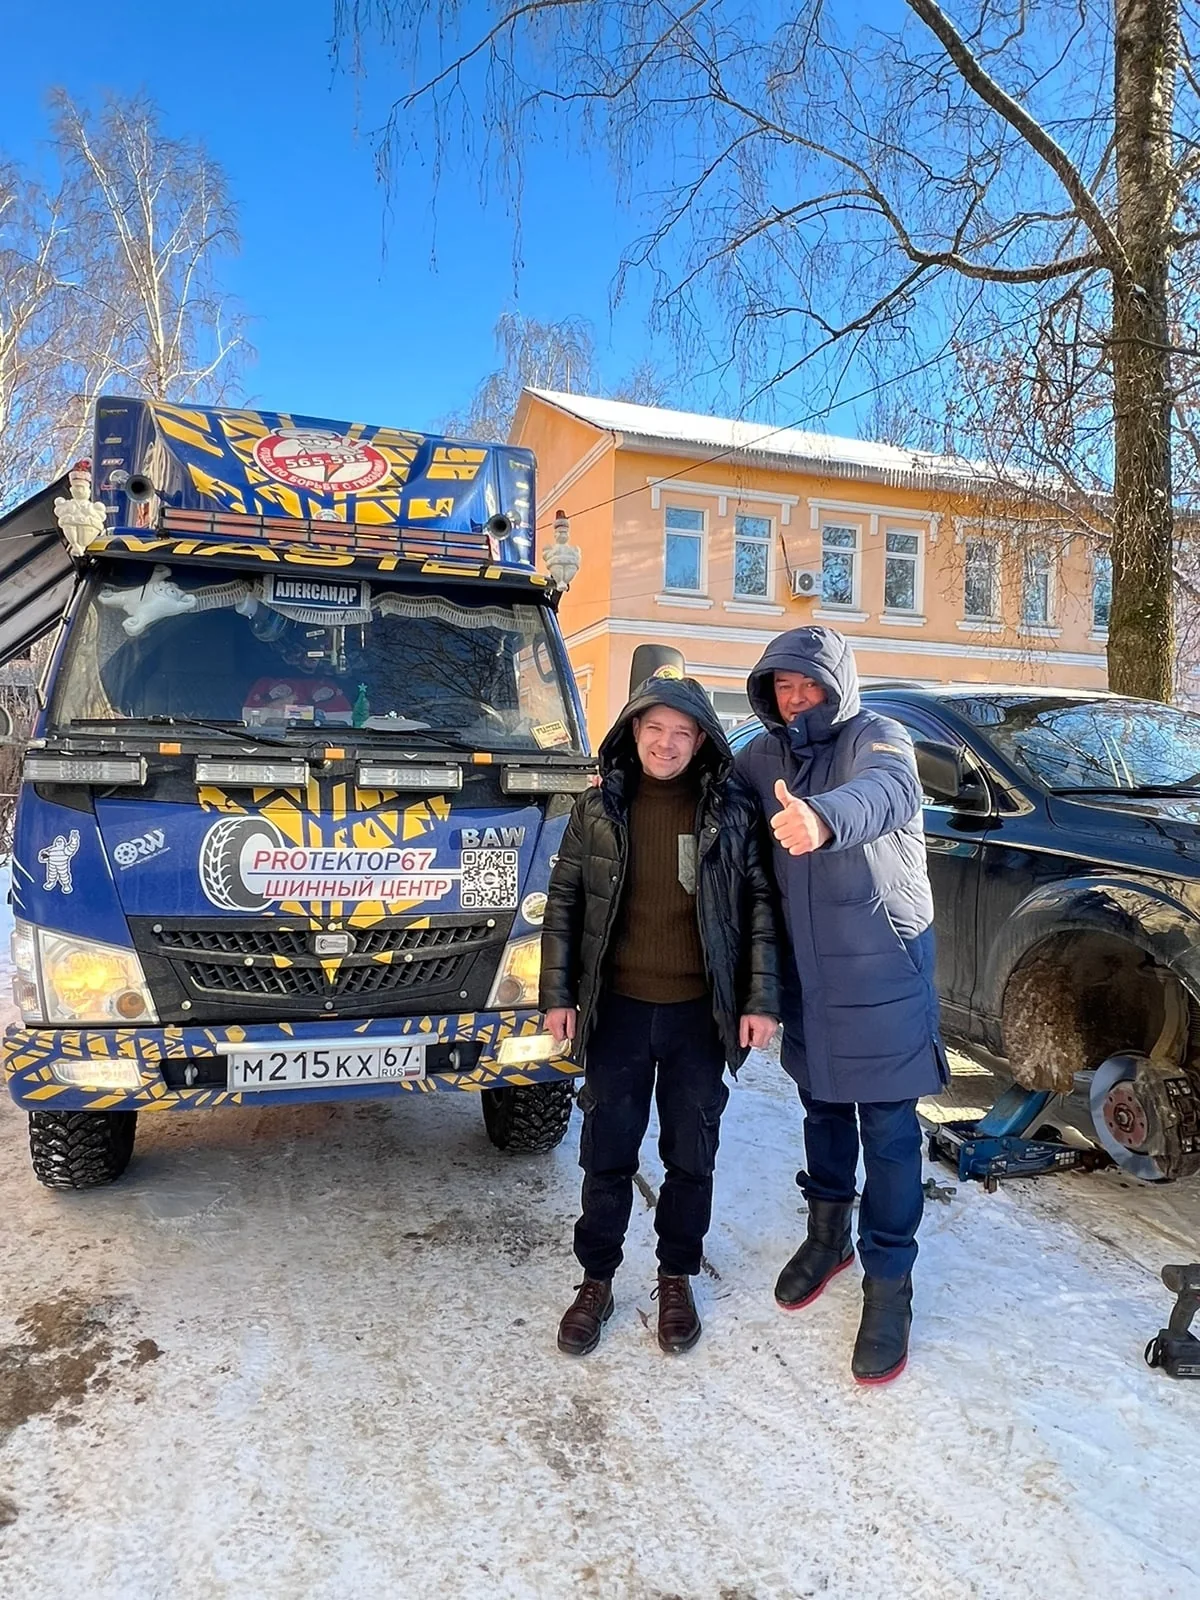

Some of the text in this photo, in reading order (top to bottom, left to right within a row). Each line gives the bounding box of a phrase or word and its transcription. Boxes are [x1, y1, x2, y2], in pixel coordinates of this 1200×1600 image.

[285, 454, 369, 468] 565-595
[271, 466, 289, 477] ПО
[288, 475, 340, 492] БОРЬБЕ
[342, 482, 352, 490] С
[275, 581, 358, 605] АЛЕКСАНДР
[461, 827, 526, 849] BAW
[265, 876, 448, 901] ШИННЫЙ ЦЕНТР
[384, 1046, 413, 1067] 67
[382, 1067, 404, 1077] RUS
